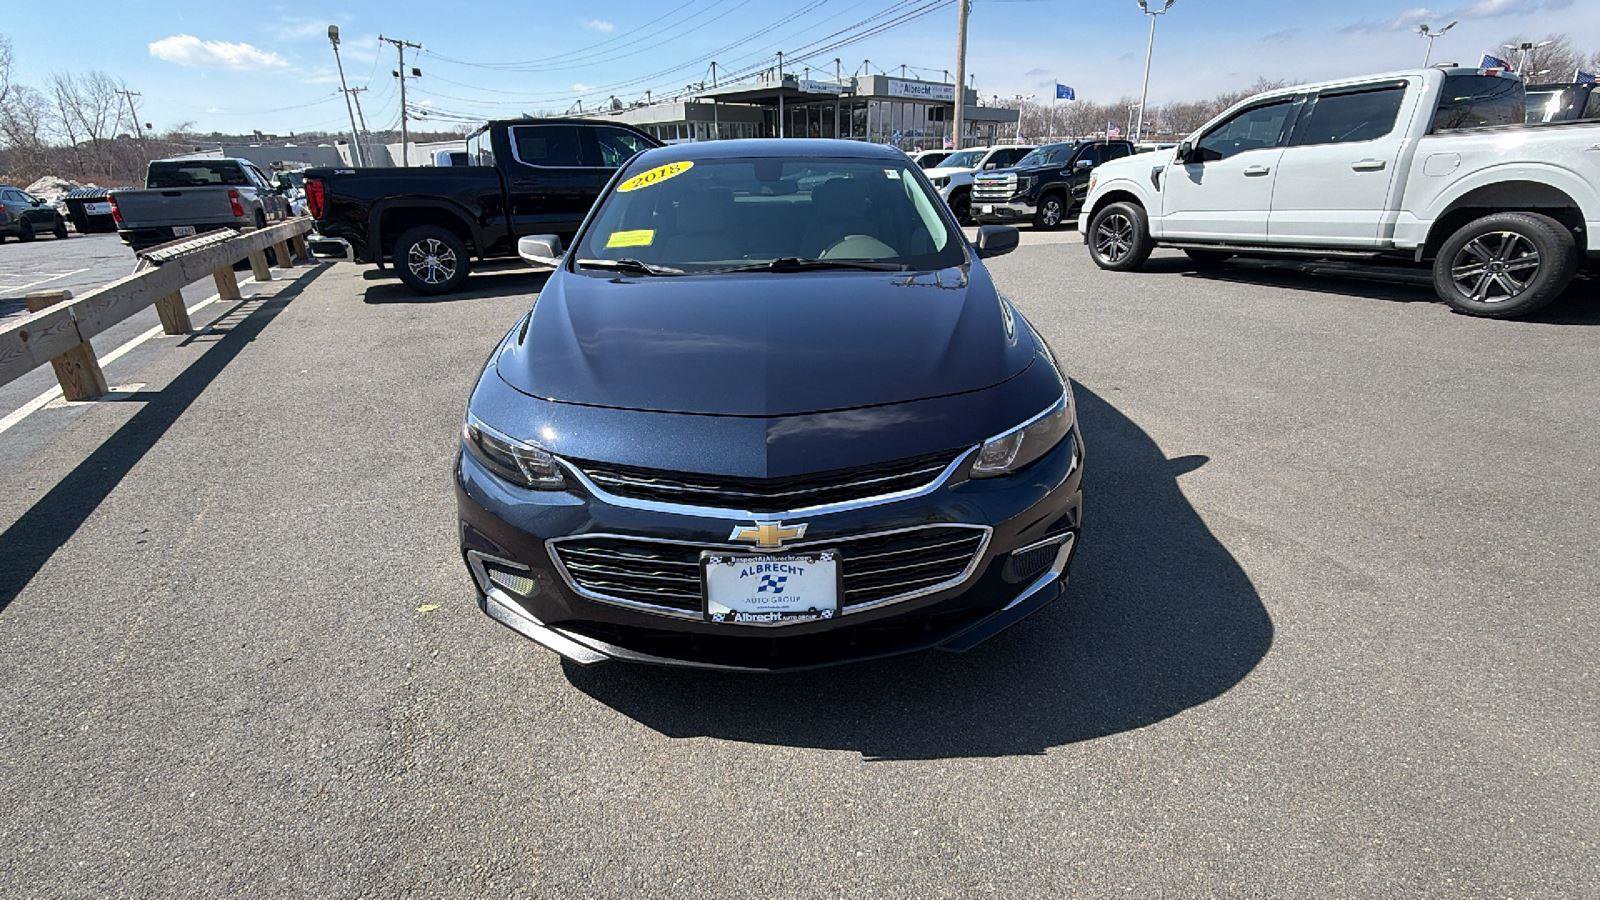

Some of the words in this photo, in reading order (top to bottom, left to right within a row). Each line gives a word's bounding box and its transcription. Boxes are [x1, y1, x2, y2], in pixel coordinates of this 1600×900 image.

[903, 83, 931, 95] Albrecht
[632, 164, 681, 188] 2018
[739, 563, 805, 579] ALBRECHT
[770, 596, 801, 604] GROUP
[734, 612, 783, 622] Albrecht
